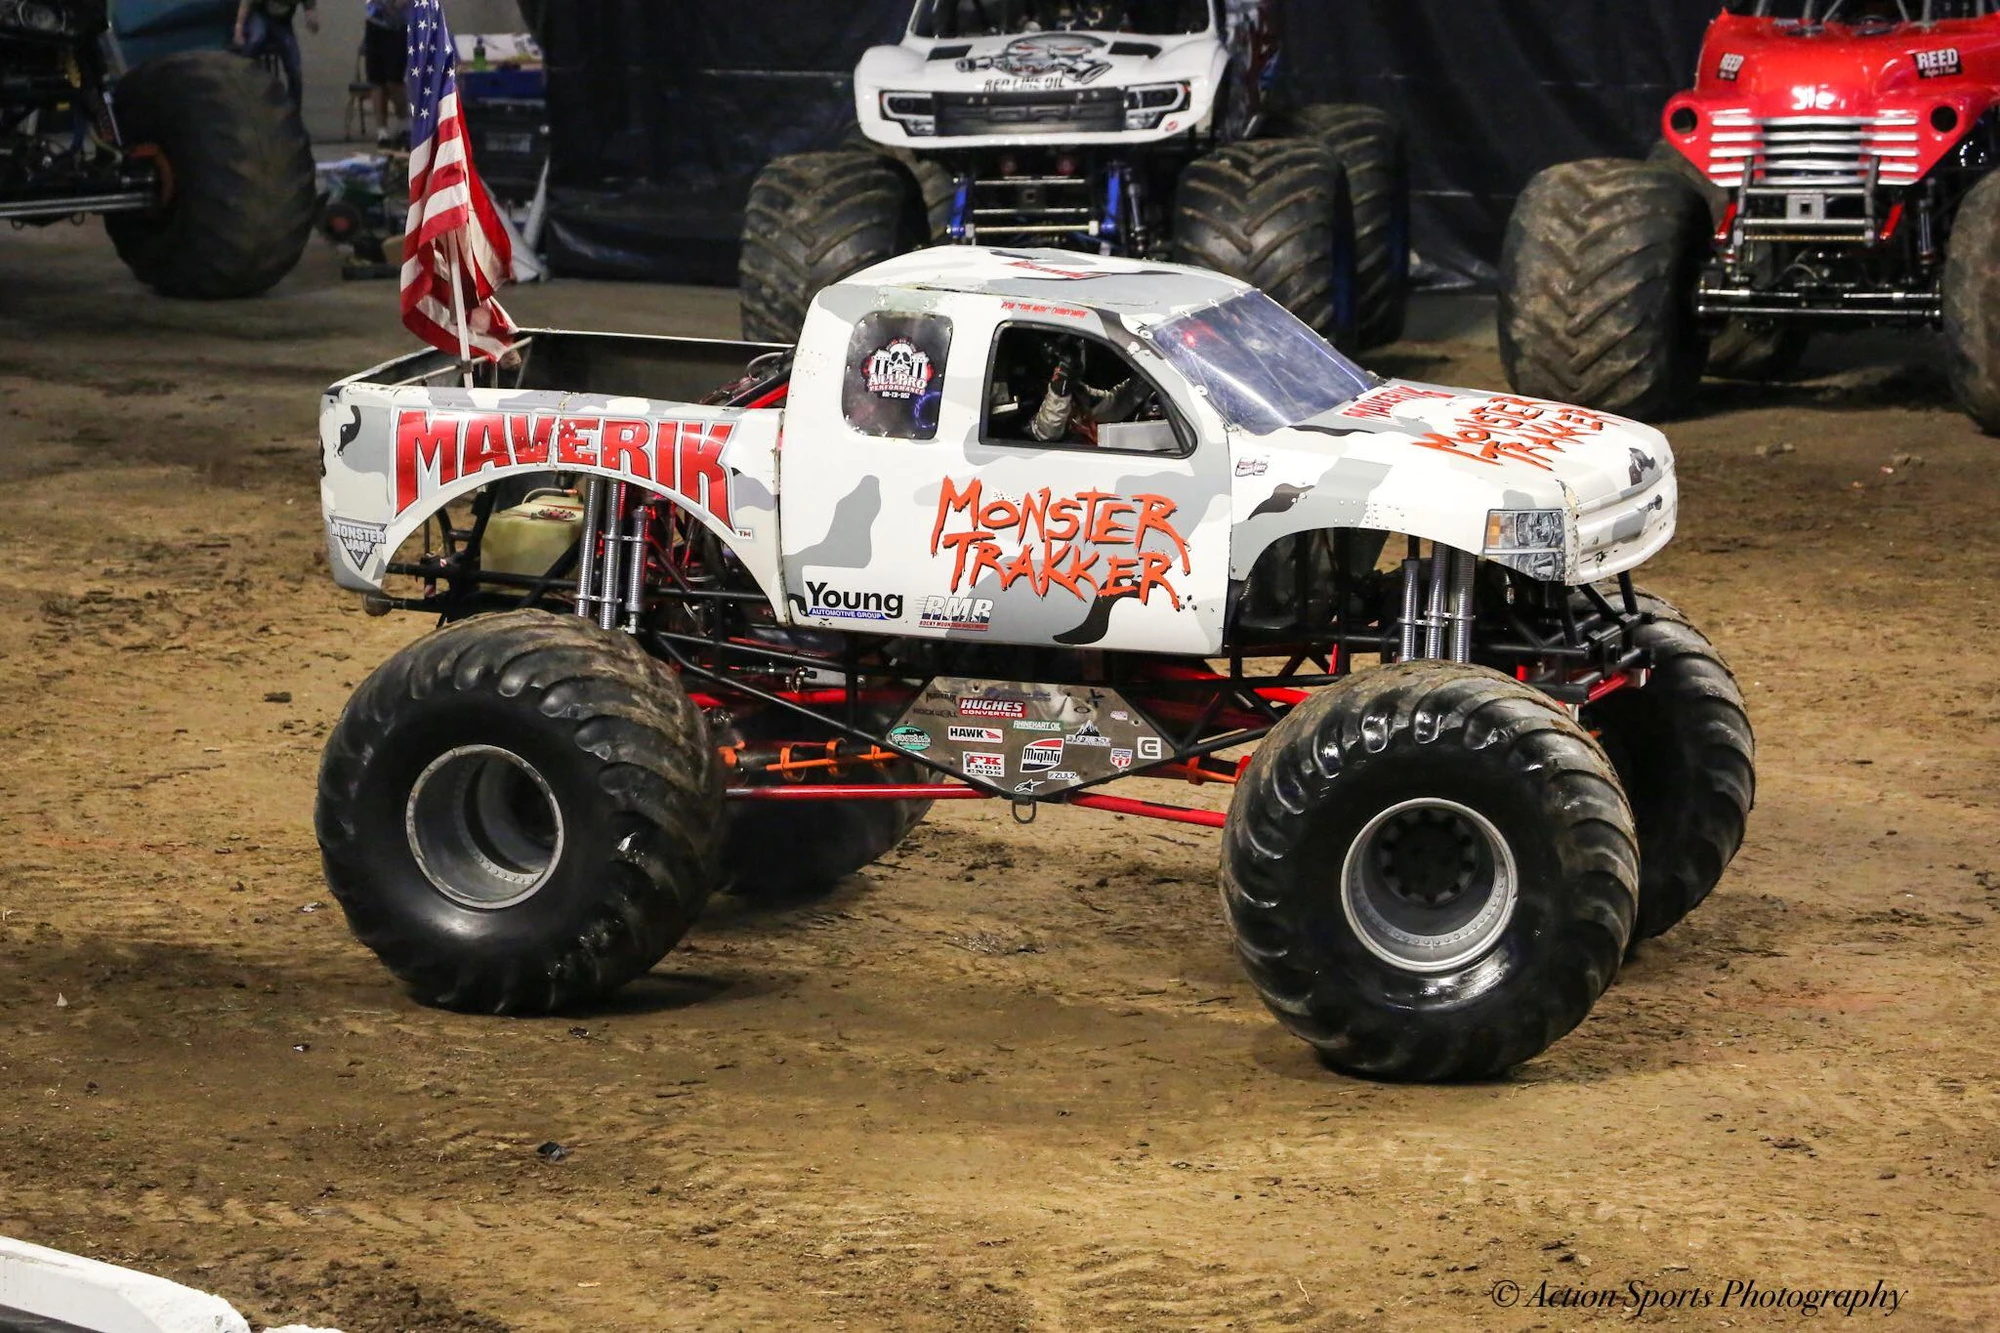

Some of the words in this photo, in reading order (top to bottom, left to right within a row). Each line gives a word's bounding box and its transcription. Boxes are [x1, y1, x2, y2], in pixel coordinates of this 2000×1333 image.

[1917, 48, 1958, 69] REED
[1045, 76, 1065, 89] OIL
[1411, 396, 1565, 466] MONSTER
[393, 408, 738, 535] MAVERIK
[330, 523, 386, 544] MONSTER
[930, 474, 1192, 577] MONSTER
[345, 538, 372, 554] JAM
[942, 530, 1181, 612] TRAKKER
[805, 581, 904, 618] Young
[811, 609, 856, 618] AUTOMOTIVE
[857, 611, 882, 619] GROUP
[922, 595, 994, 623] RMR
[960, 700, 1024, 712] HUGHES
[961, 709, 1024, 718] CONVERTERS
[950, 728, 984, 738] HAWK
[1050, 722, 1061, 731] OIL
[1023, 748, 1061, 764] Mighty
